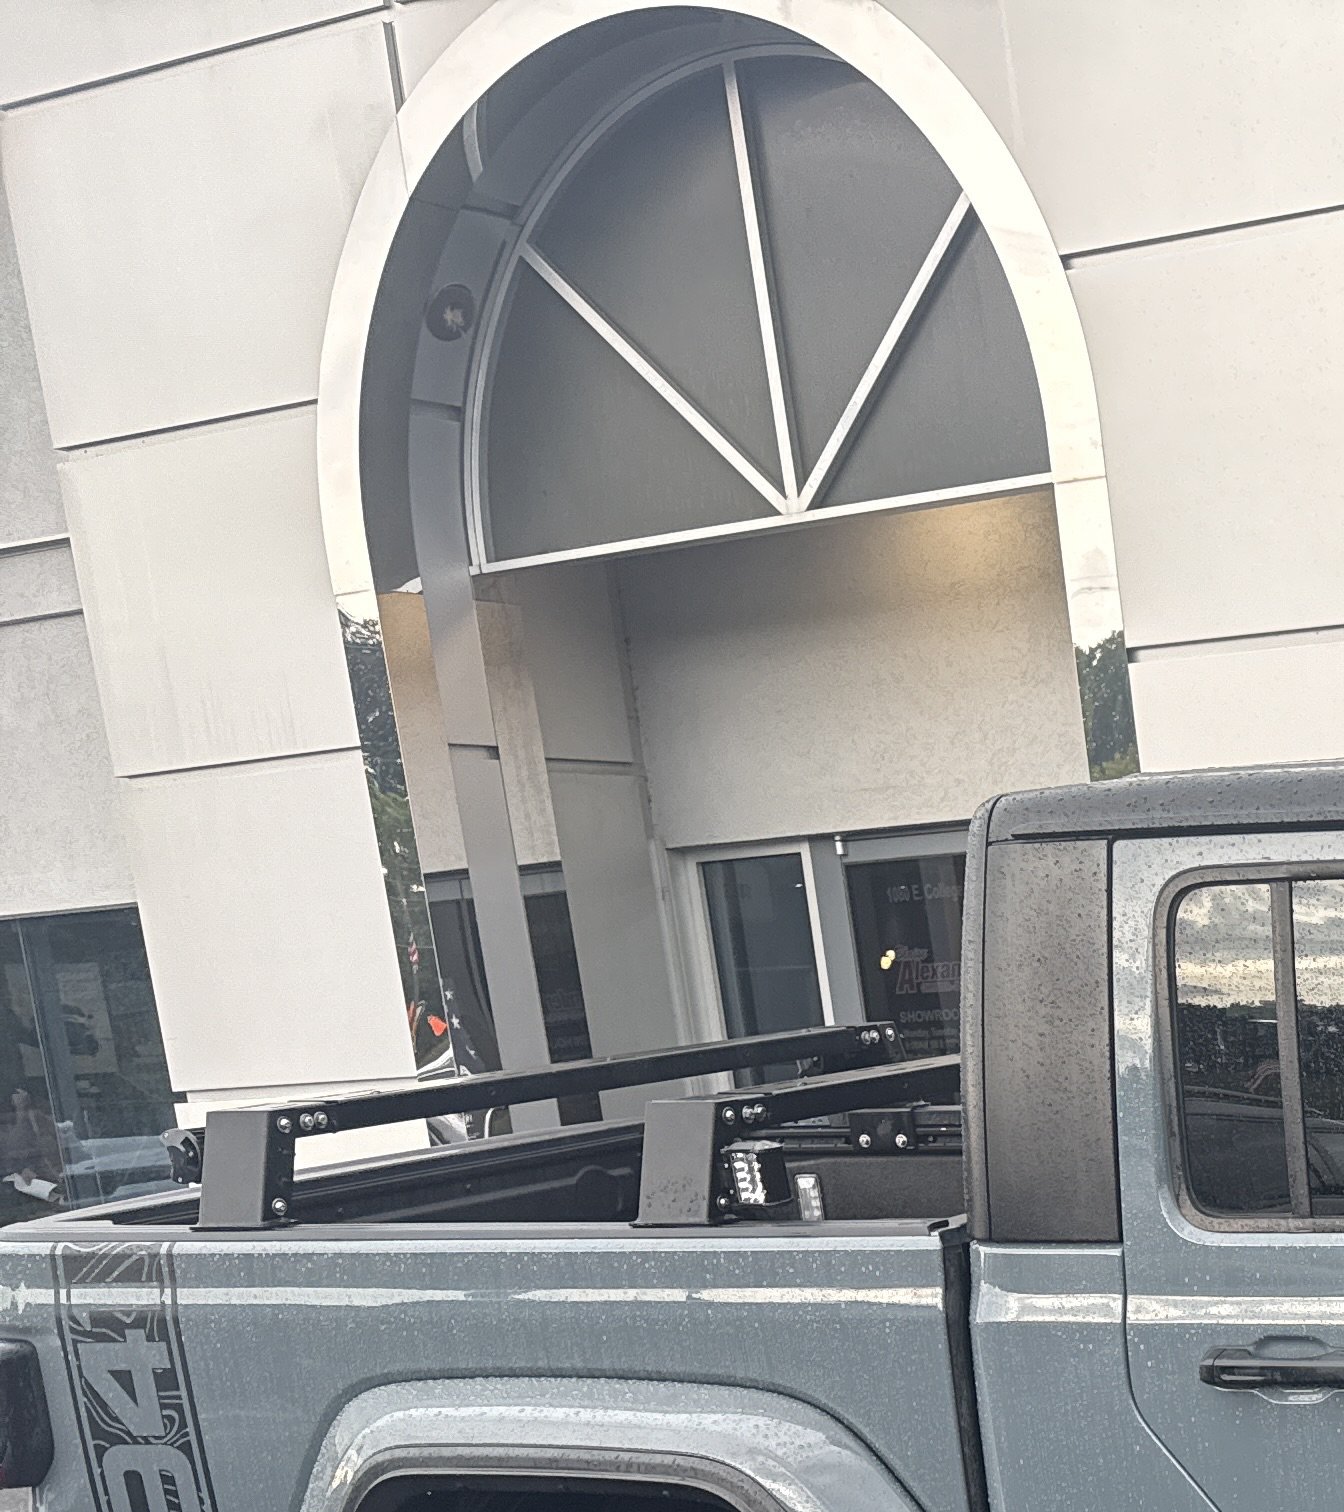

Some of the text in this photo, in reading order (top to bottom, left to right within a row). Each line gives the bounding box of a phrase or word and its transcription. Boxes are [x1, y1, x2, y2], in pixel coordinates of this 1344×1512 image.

[924, 882, 962, 903] Colleg
[896, 960, 961, 994] Alexan
[900, 1008, 961, 1023] SHOWROO
